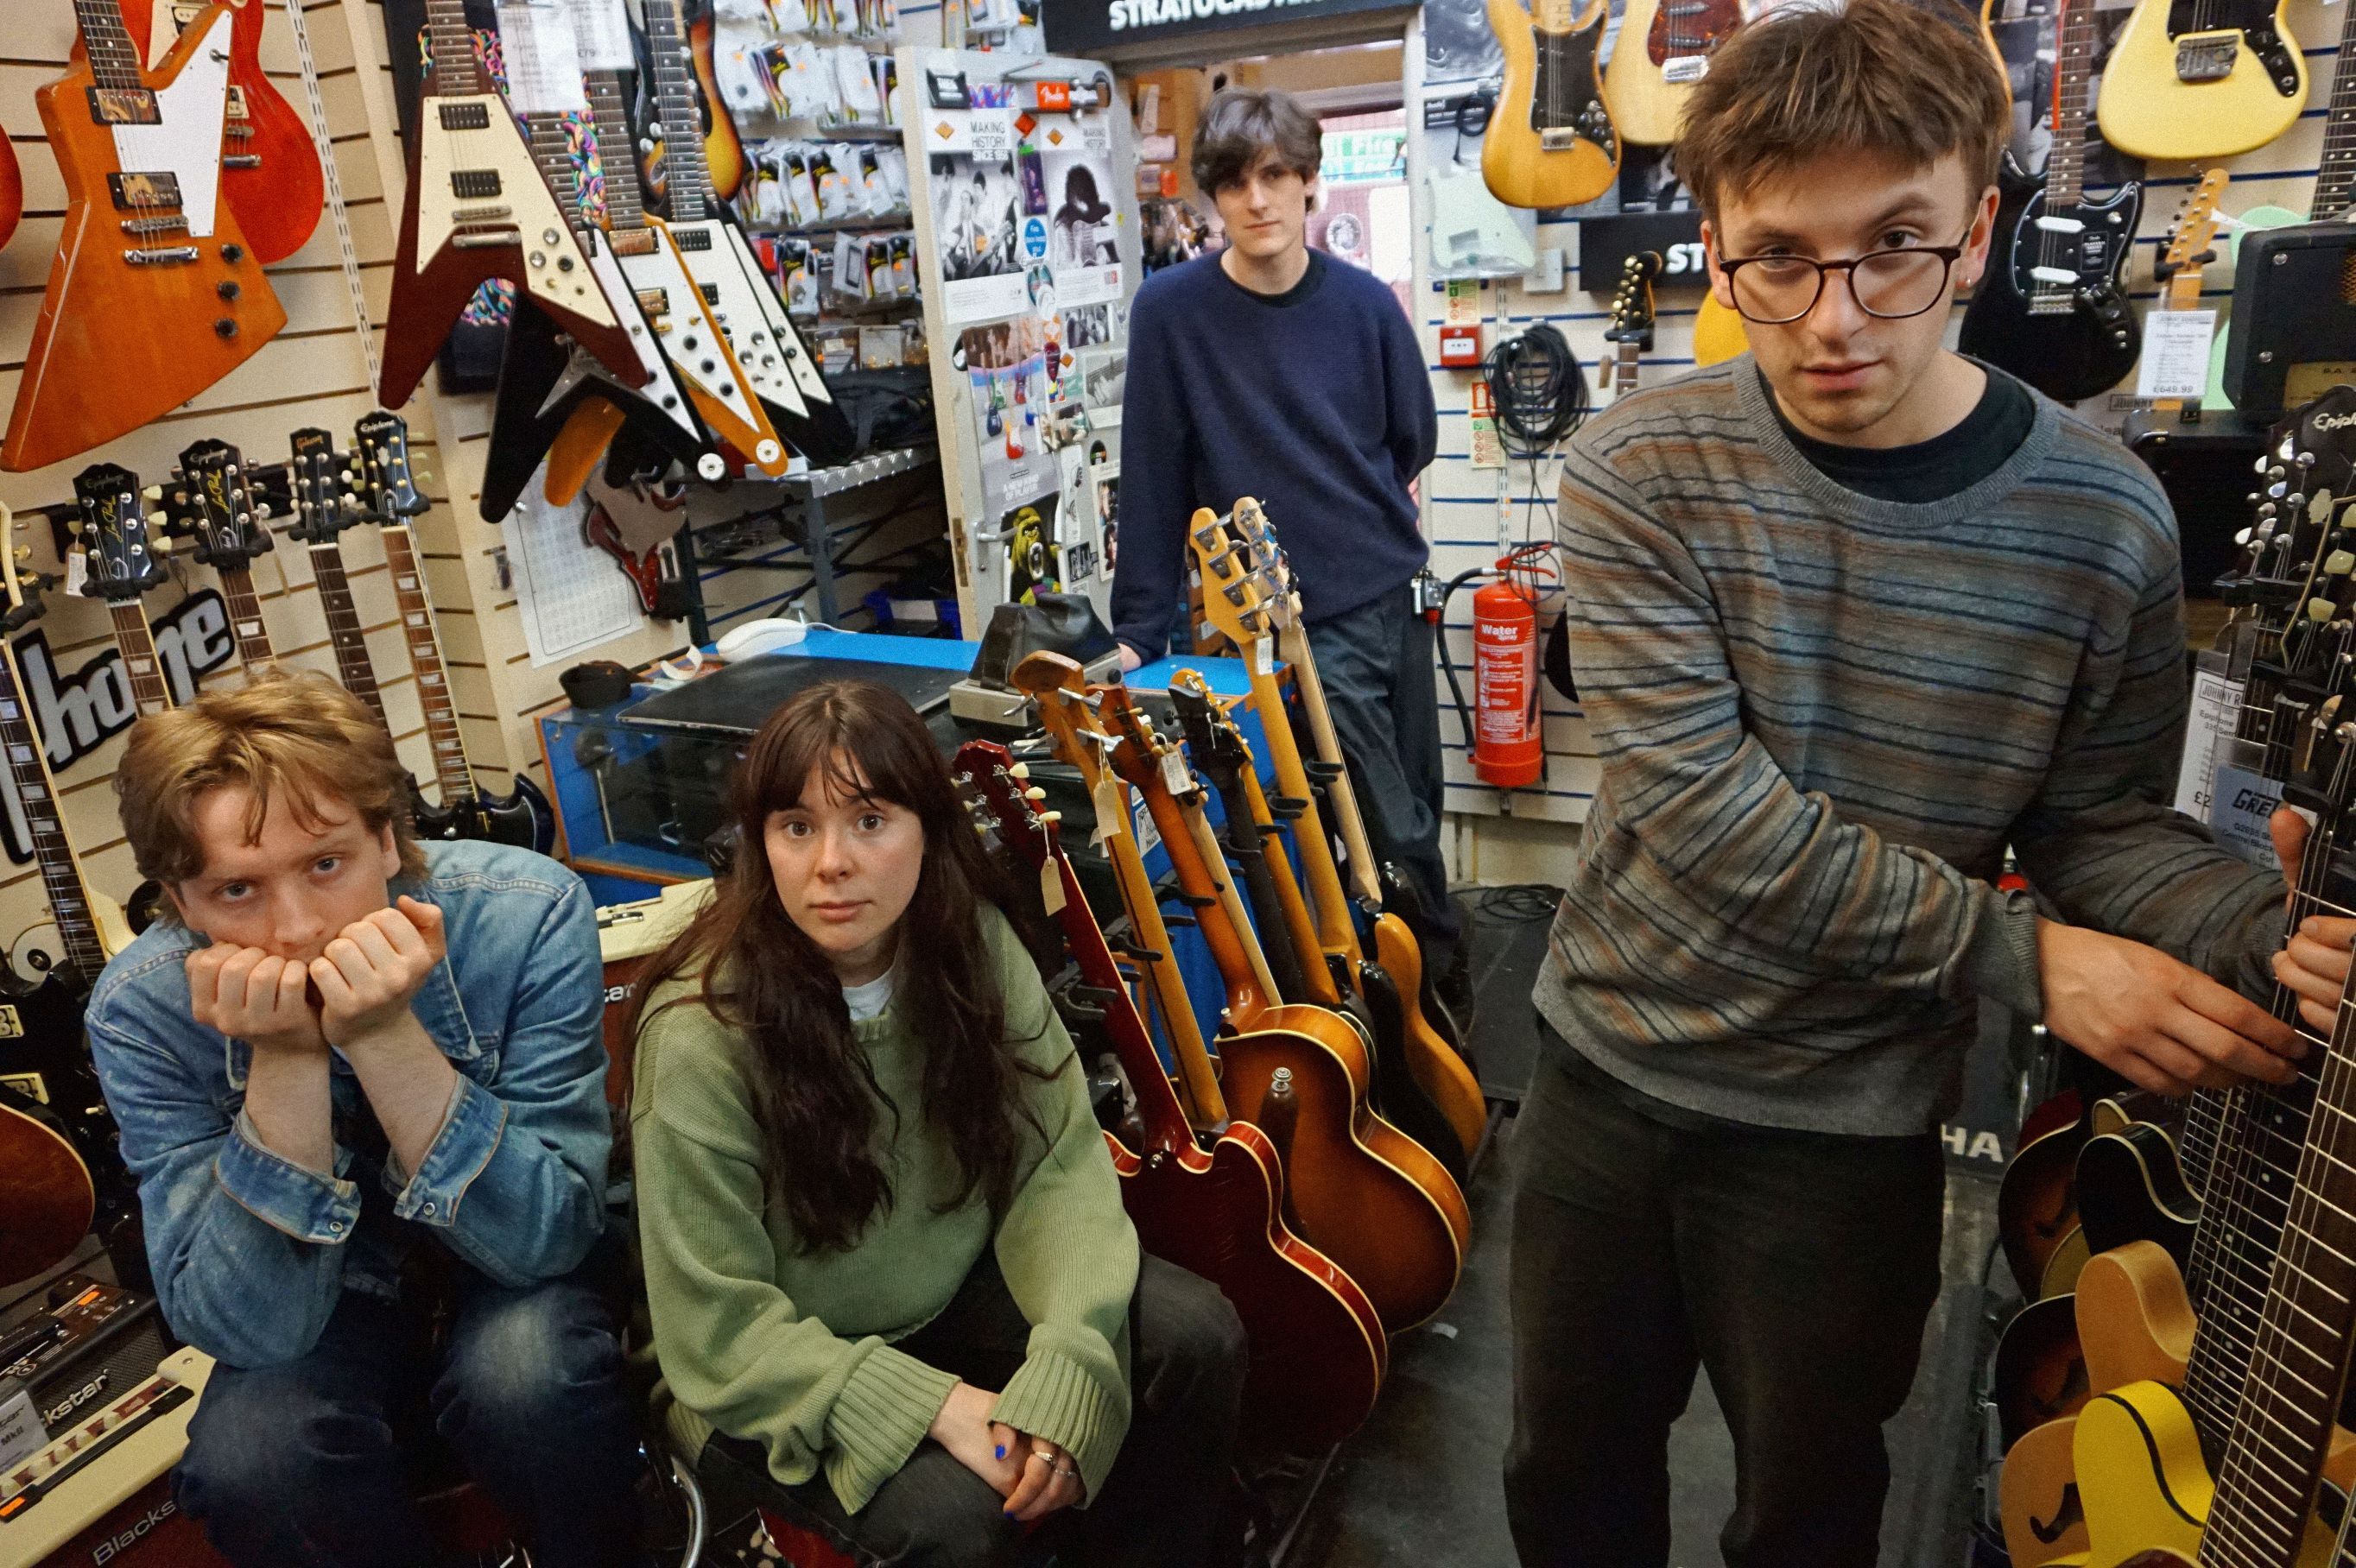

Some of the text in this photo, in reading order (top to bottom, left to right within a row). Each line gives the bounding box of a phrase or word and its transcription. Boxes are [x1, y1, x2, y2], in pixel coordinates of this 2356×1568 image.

[1109, 0, 1322, 30] STRATO
[970, 119, 1005, 134] MAKING
[972, 135, 1005, 149] HISTORY
[360, 420, 396, 433] Epiphone
[1481, 624, 1518, 635] Water
[2202, 683, 2232, 704] JOHNNY
[2199, 710, 2234, 727] Epiphone
[92, 1501, 177, 1567] Blacks
